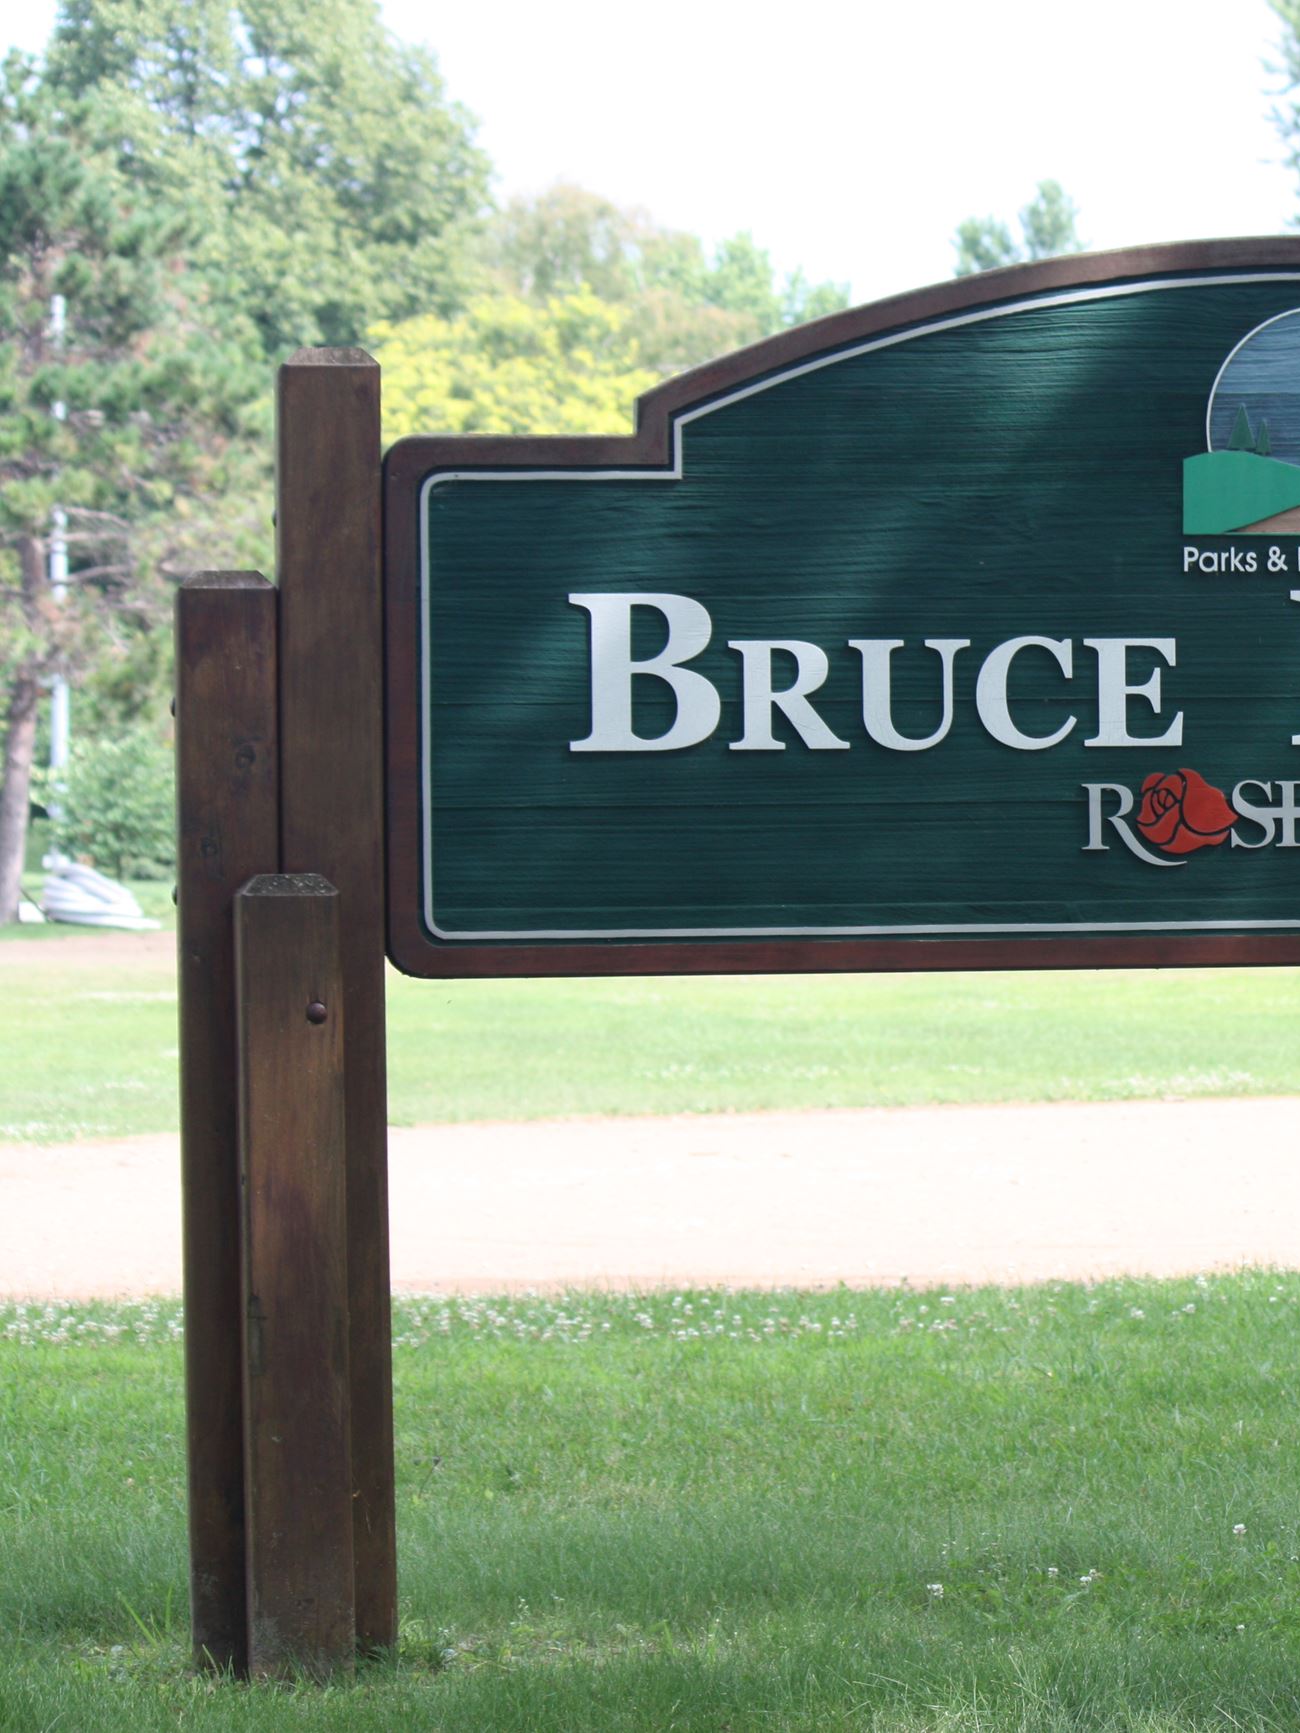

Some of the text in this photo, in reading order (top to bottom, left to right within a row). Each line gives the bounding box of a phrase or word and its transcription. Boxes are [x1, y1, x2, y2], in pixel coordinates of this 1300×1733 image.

[1183, 546, 1257, 573] Parks
[1267, 546, 1288, 572] &
[569, 592, 1184, 752] BRUCE
